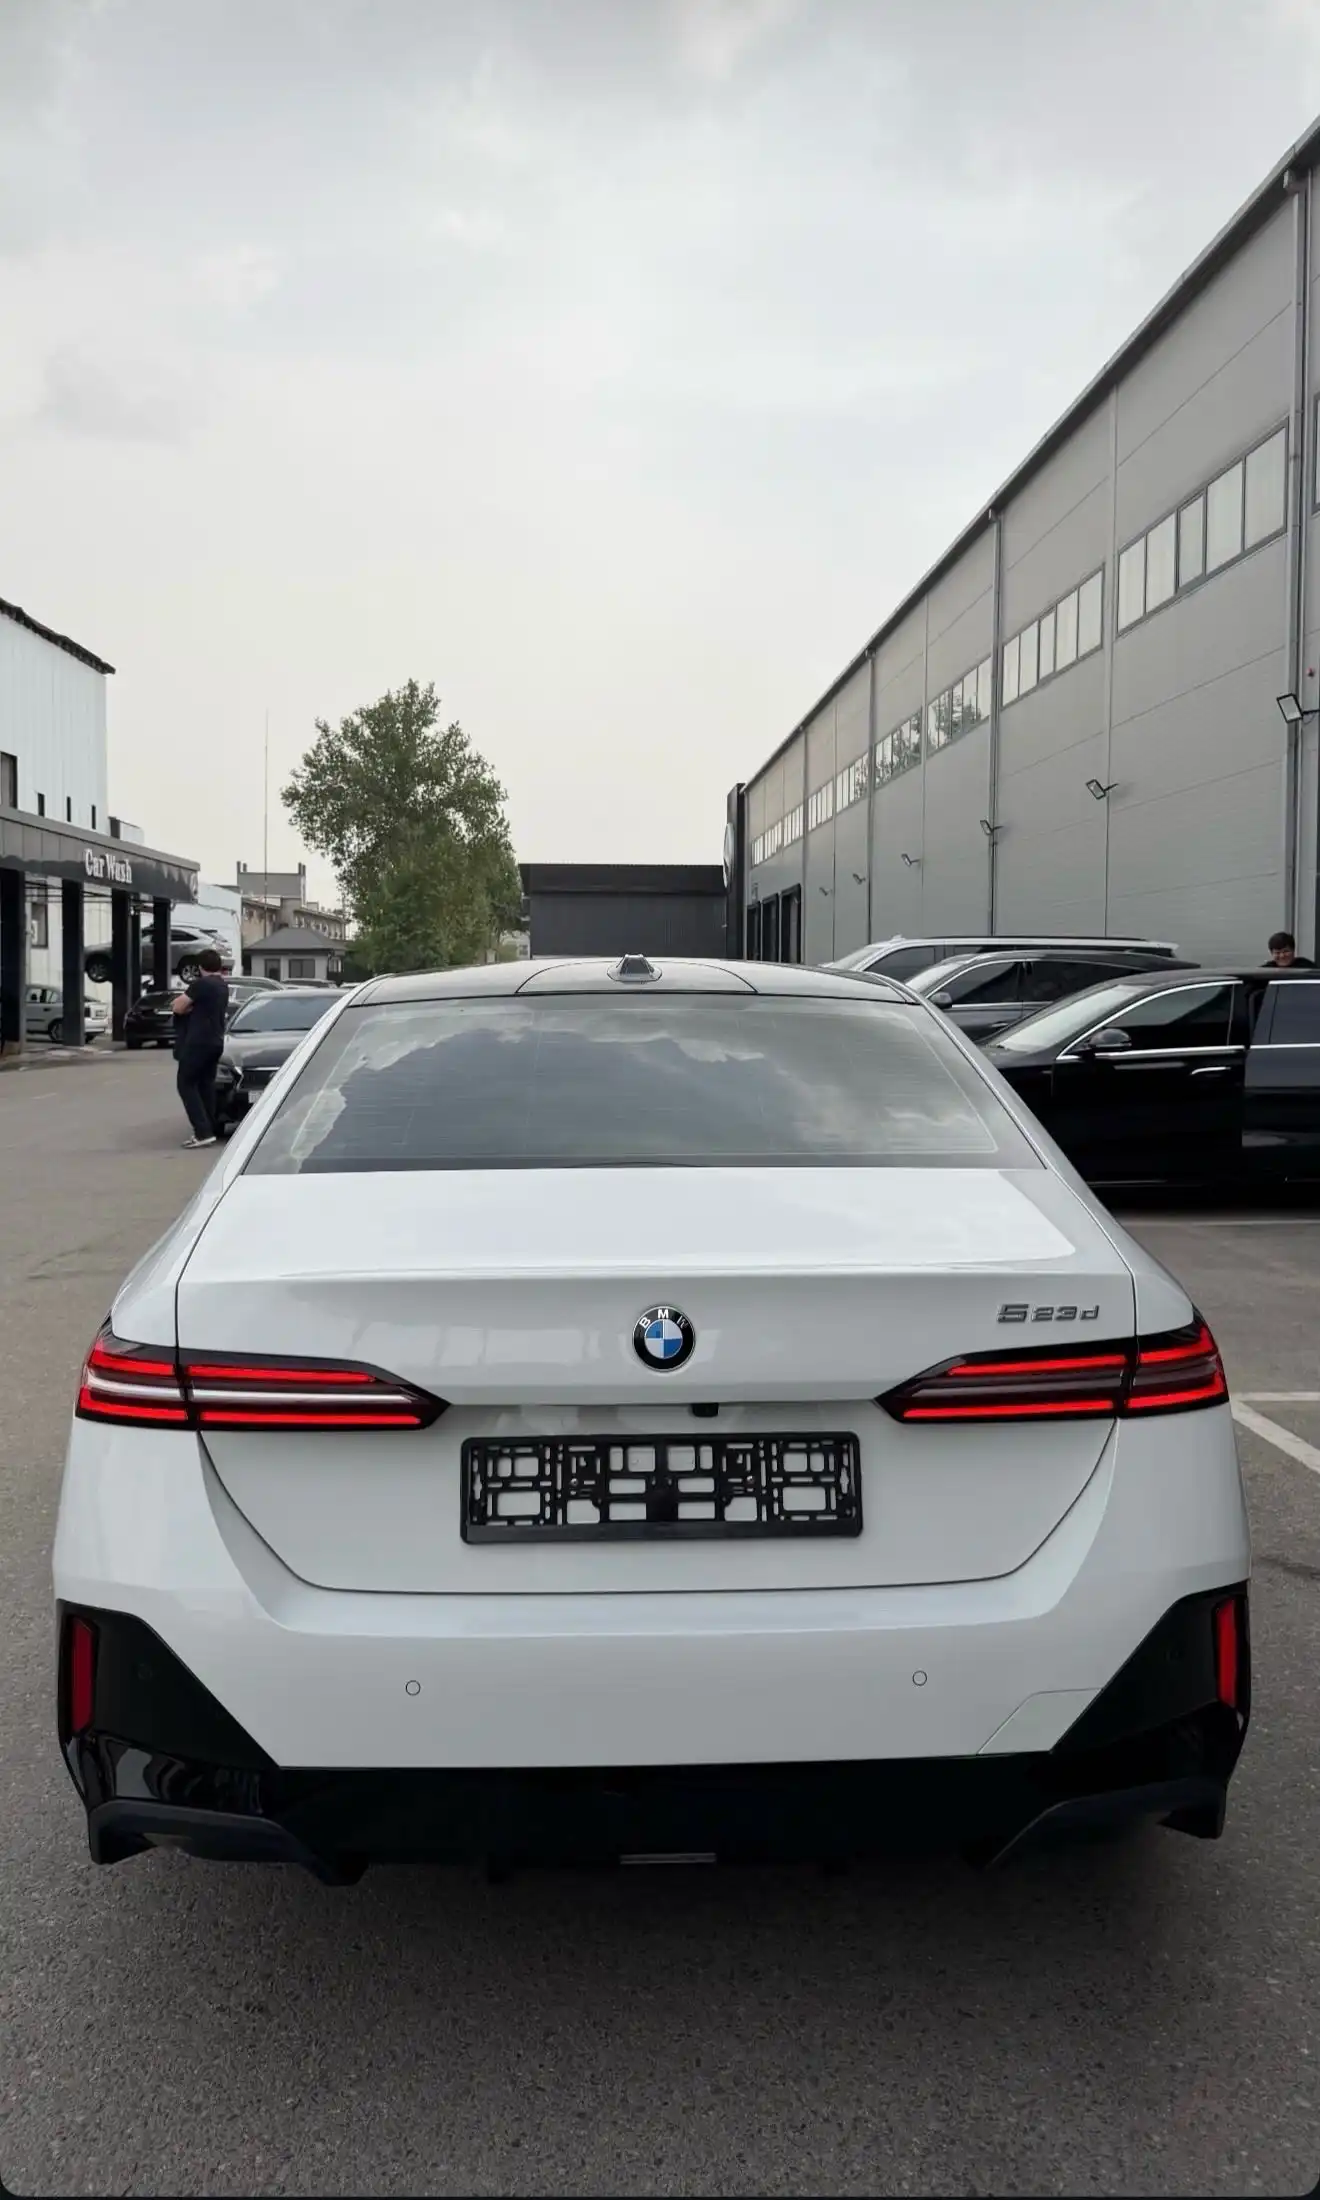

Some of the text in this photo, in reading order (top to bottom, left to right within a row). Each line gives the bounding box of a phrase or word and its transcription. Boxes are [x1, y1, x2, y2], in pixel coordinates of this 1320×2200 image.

[85, 849, 132, 884] Car Wash
[639, 1308, 689, 1329] BMW
[997, 1303, 1100, 1324] 523d
